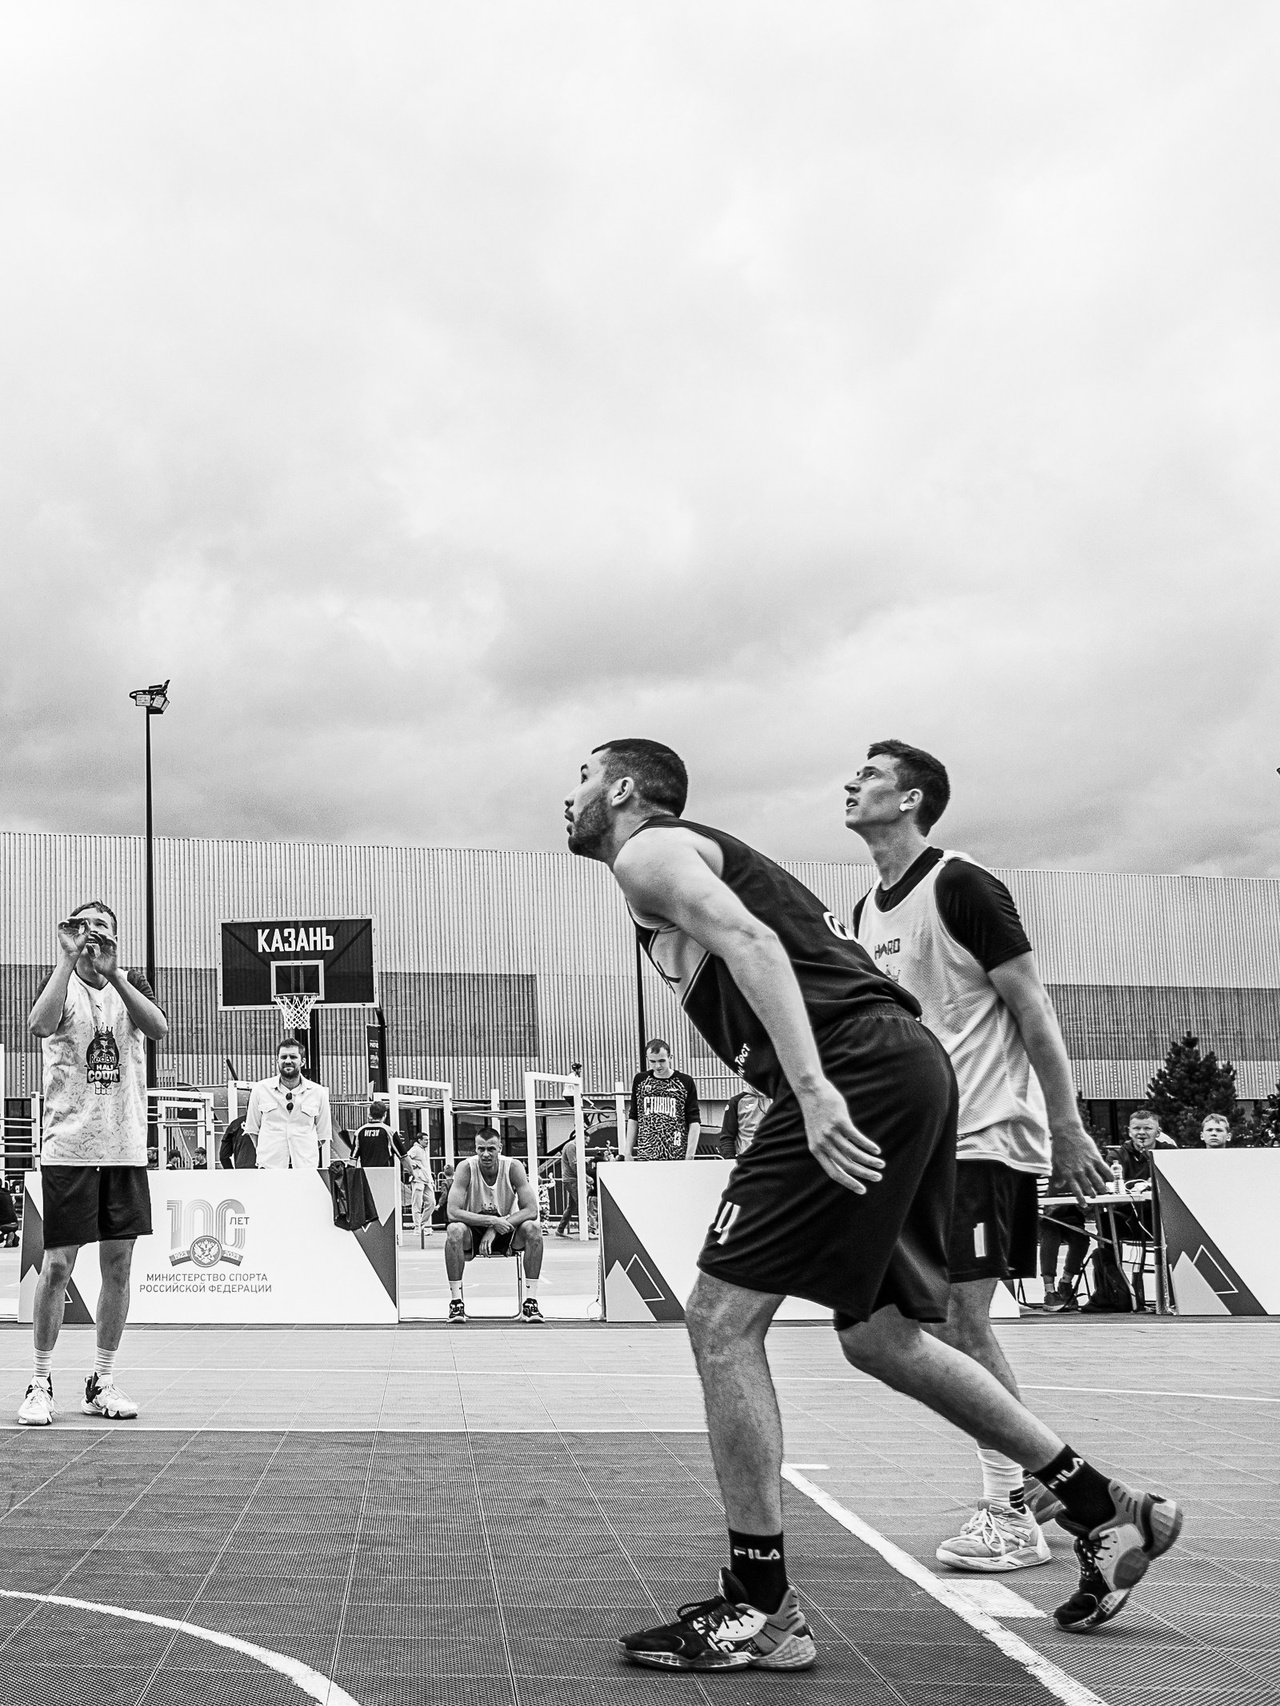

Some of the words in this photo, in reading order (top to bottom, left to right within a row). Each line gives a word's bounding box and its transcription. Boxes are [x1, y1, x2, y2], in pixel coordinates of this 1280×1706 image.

[257, 927, 334, 953] КАЗАНЬ
[229, 1217, 250, 1226] ЛЕТ
[973, 1222, 987, 1258] 1
[146, 1273, 226, 1282] МИНИСТЕРСТВО
[228, 1273, 268, 1282] СПОРТА
[139, 1282, 206, 1293] РОССИЙСКОЙ
[208, 1284, 272, 1294] ФЕДЕРАЦИИ
[1048, 1457, 1084, 1489] FILA
[733, 1545, 781, 1560] FILA
